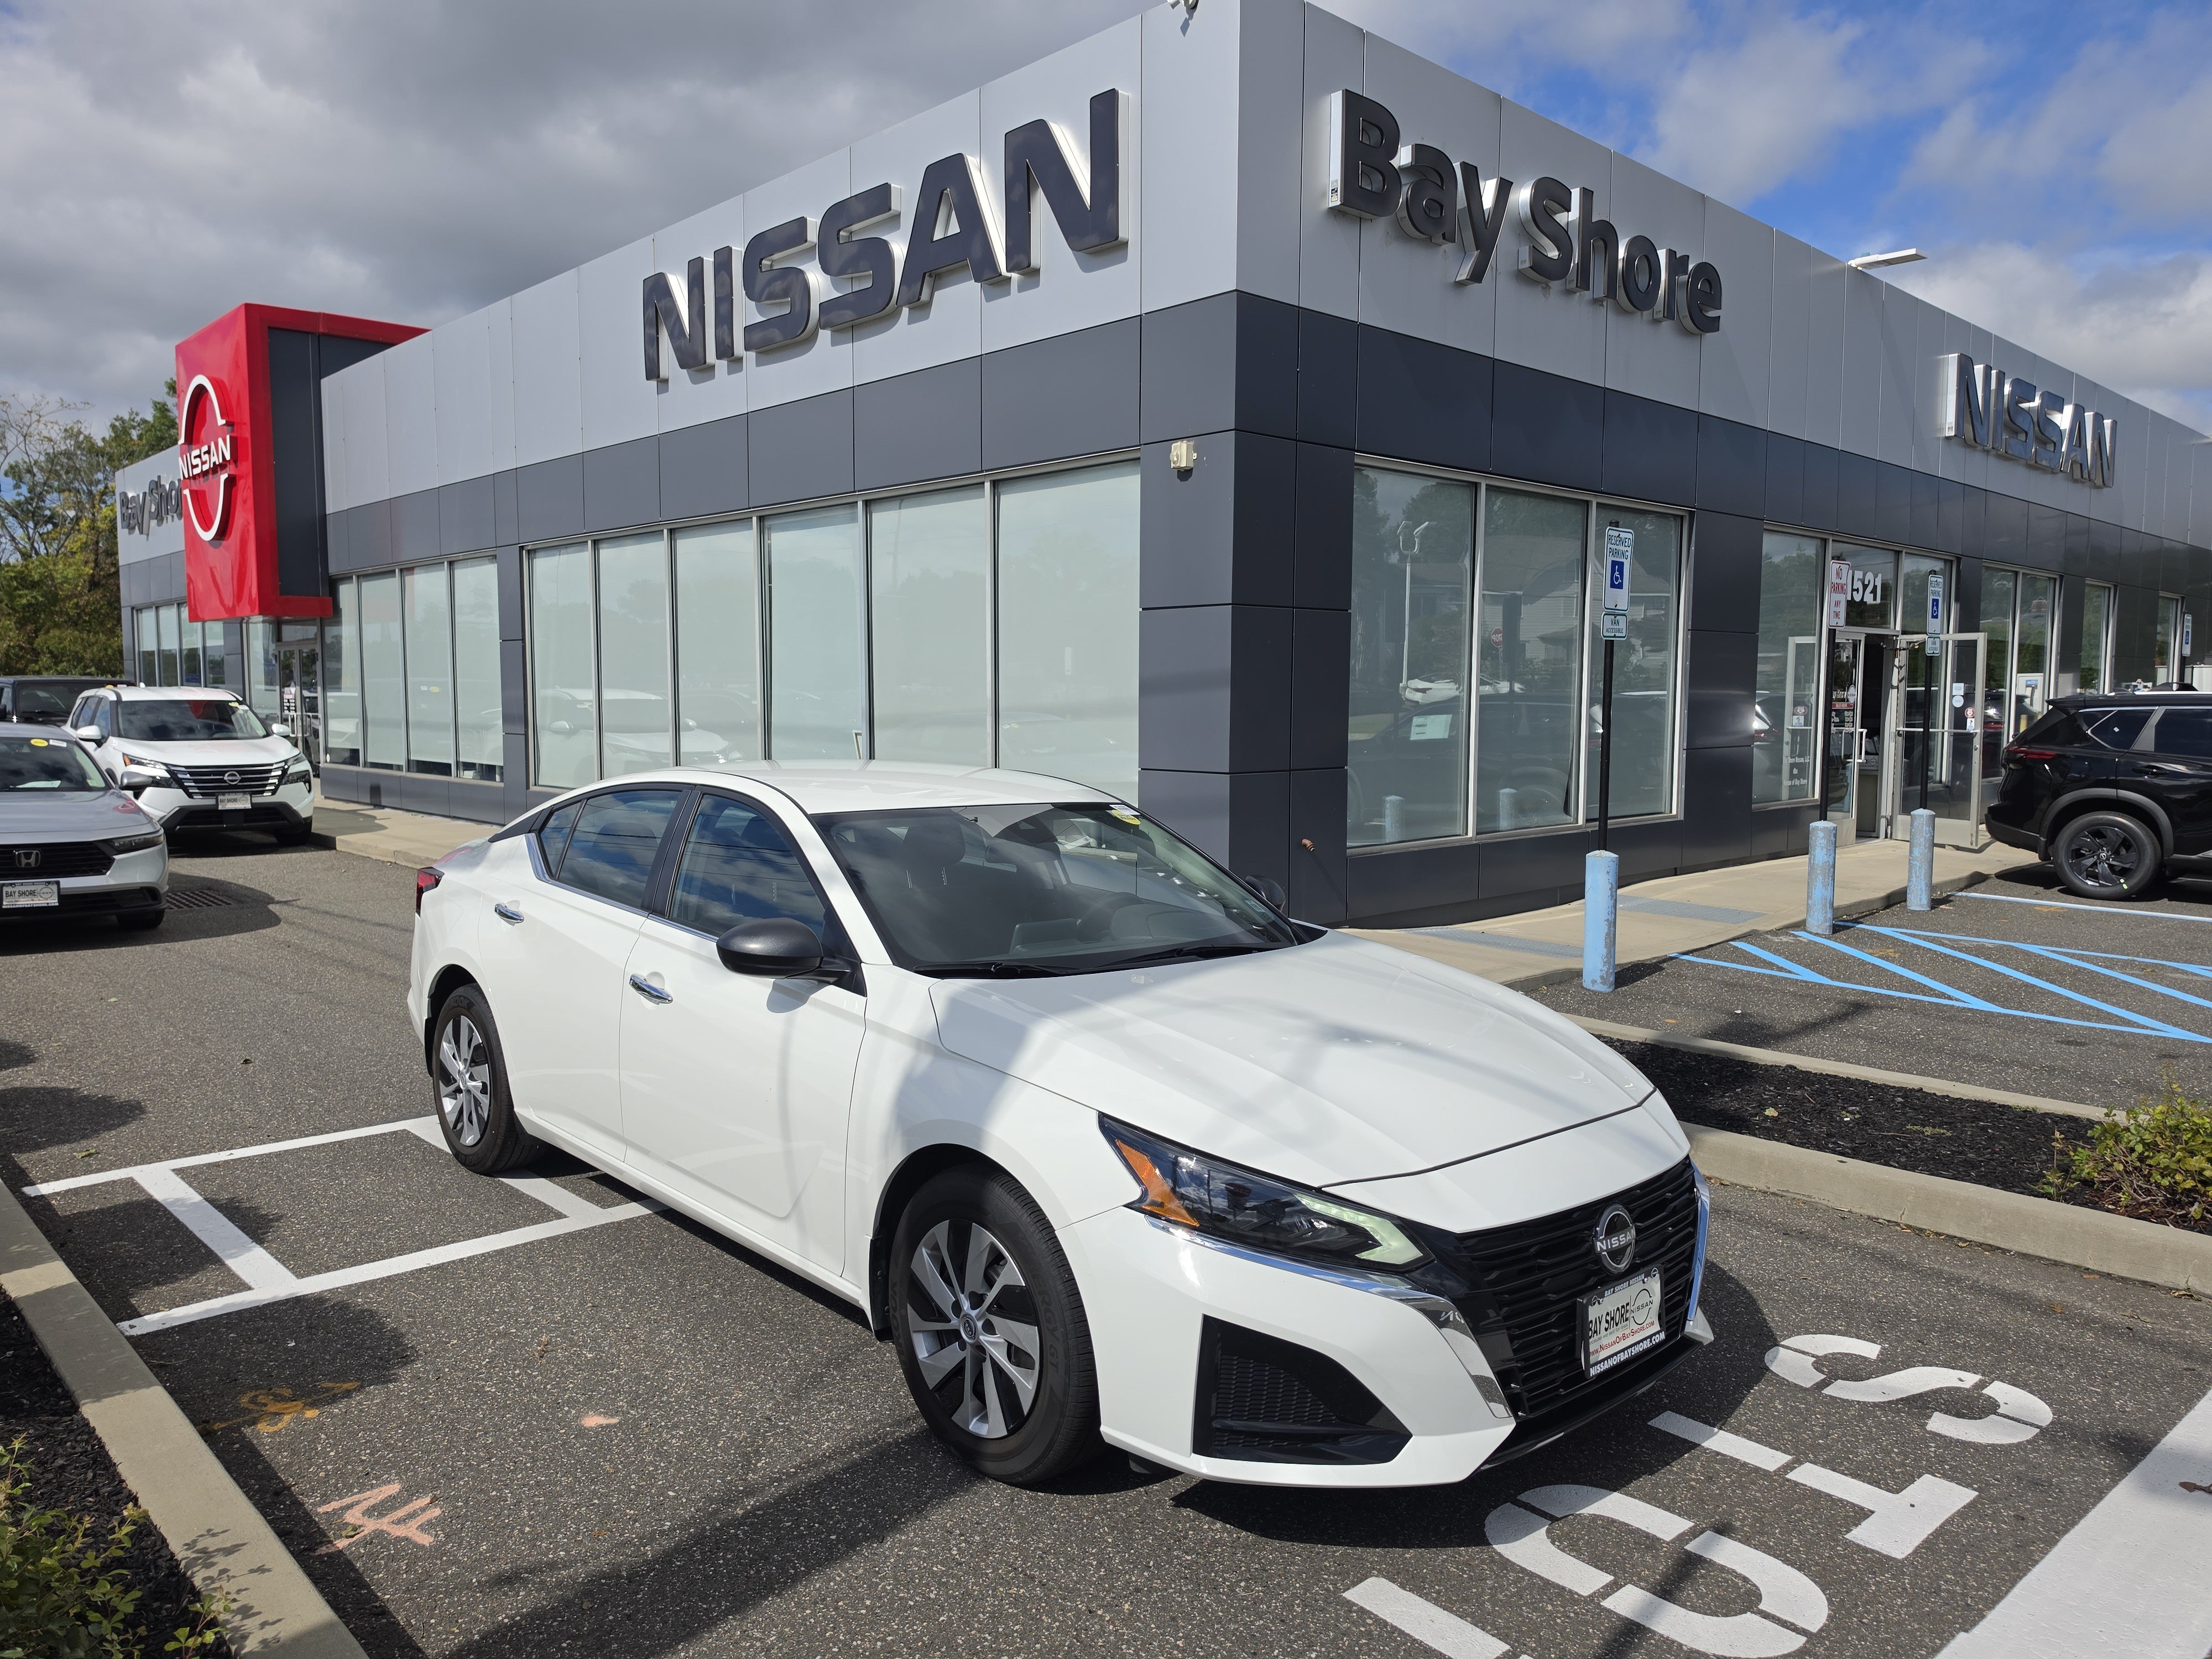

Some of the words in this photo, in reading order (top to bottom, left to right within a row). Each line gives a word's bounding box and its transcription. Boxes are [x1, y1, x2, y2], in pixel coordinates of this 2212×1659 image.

[1329, 89, 1513, 285] Bay
[1519, 176, 1722, 334] Shore
[643, 88, 1125, 382] NISSAN
[1945, 353, 2117, 488] NISSAN
[178, 434, 231, 480] NISSAN
[119, 492, 150, 535] Bay
[149, 475, 183, 521] Shor
[1608, 534, 1631, 548] RESERVED
[1609, 547, 1629, 560] PARKING
[1835, 567, 1843, 580] NO
[1847, 570, 1882, 603] 1521
[1830, 582, 1846, 594] PARKING
[1610, 618, 1620, 627] VAN
[18, 889, 38, 898] SHORE
[1596, 1228, 1635, 1251] NISSAN
[1604, 1287, 1614, 1297] BAY
[1614, 1281, 1629, 1293] SHORE
[1629, 1273, 1645, 1286] NISSAN
[1589, 1314, 1603, 1339] BAY
[1604, 1302, 1630, 1332] SHORE
[1631, 1300, 1653, 1314] NISSAN
[1590, 1331, 1665, 1376] NISSANOFBAYSHORE.COM
[1342, 1333, 2054, 1659] STO
